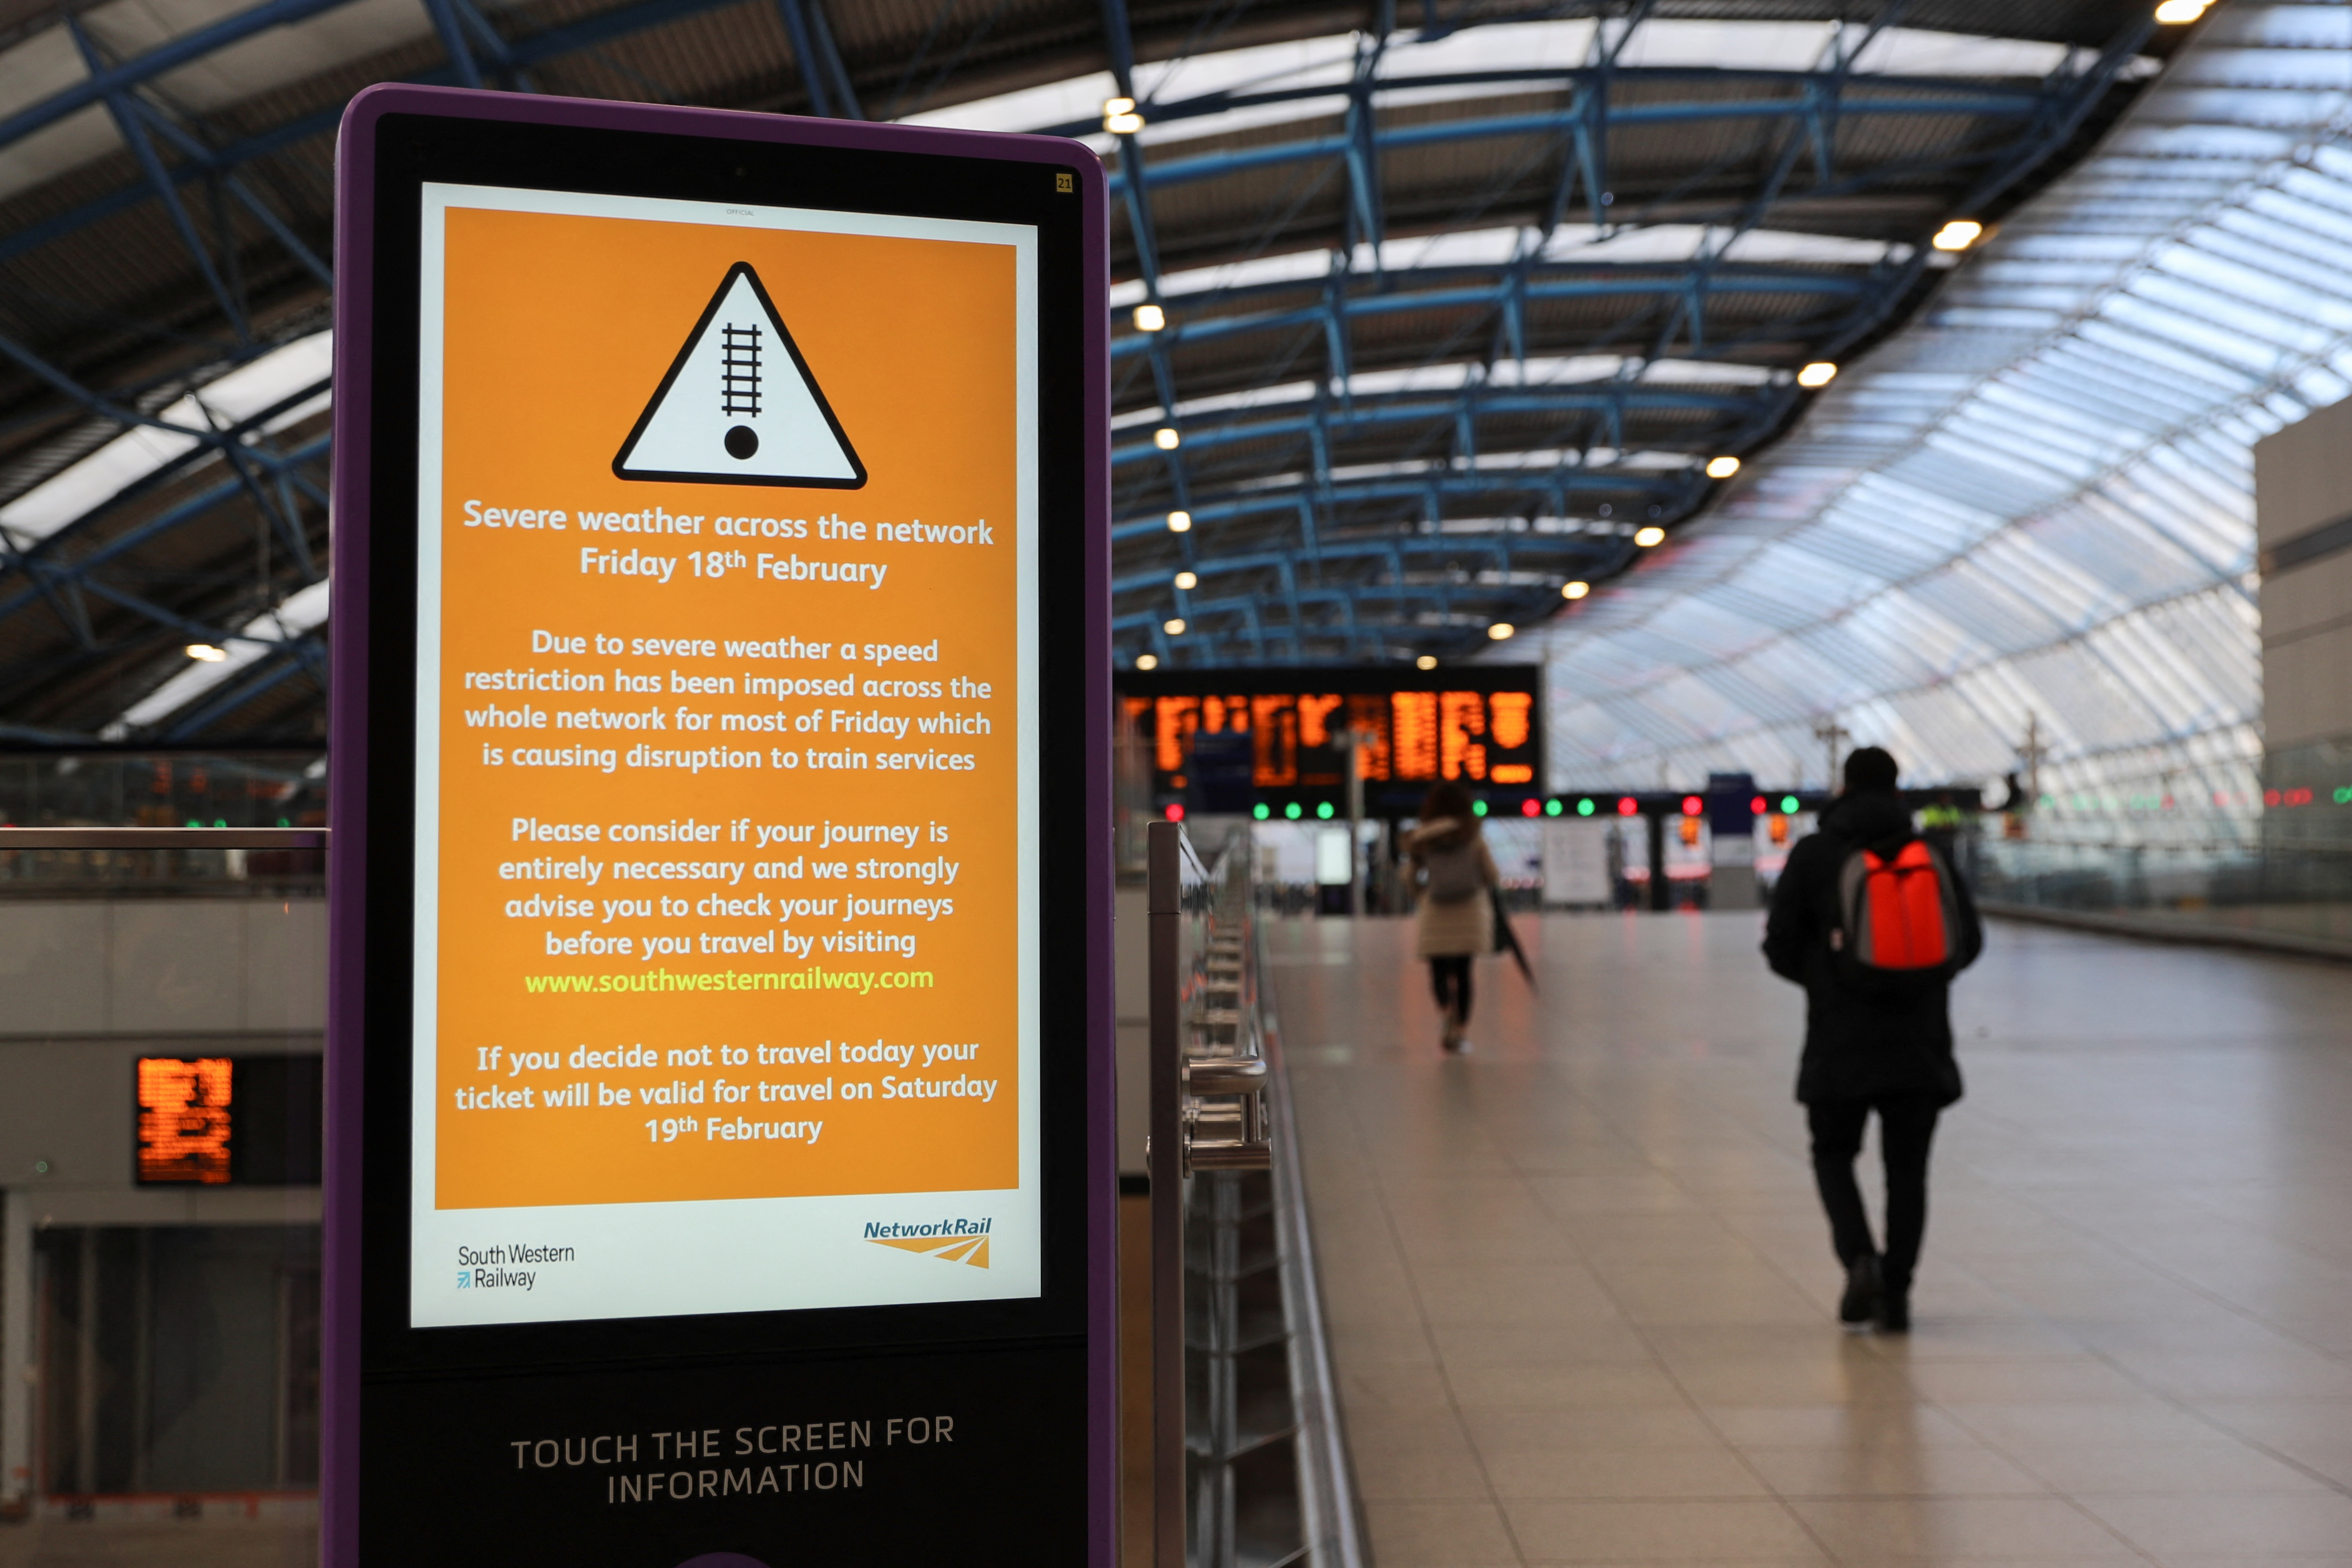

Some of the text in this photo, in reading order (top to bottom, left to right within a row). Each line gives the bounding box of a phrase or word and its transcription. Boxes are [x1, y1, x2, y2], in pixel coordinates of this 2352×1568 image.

[1058, 178, 1071, 189] 21
[463, 499, 994, 545] Severe weather across the network
[580, 547, 888, 590] Friday 18th February
[532, 629, 938, 667] Due to severe weather a speed
[465, 668, 992, 702] restriction has been imposed across the
[464, 703, 991, 740] whole network for most of Friday which
[483, 743, 976, 774] is causing disruption to train services
[512, 817, 949, 849] Please consider if your journey is
[498, 855, 960, 886] entirely necessary and we strongly
[505, 892, 954, 924] advise you to check your journeys
[546, 929, 916, 961] before you travel by visiting
[525, 966, 933, 995] www.southwesternrailway.com
[477, 1039, 979, 1077] If you decide not to travel today your
[455, 1074, 998, 1110] ticket will be valid for travel on Saturday
[645, 1115, 823, 1145] 19th February
[458, 1243, 574, 1266] South Western
[475, 1267, 536, 1291] Railway
[511, 1416, 954, 1469] TOUCH THE SCREEN FOR
[609, 1460, 863, 1504] INFORMATION
